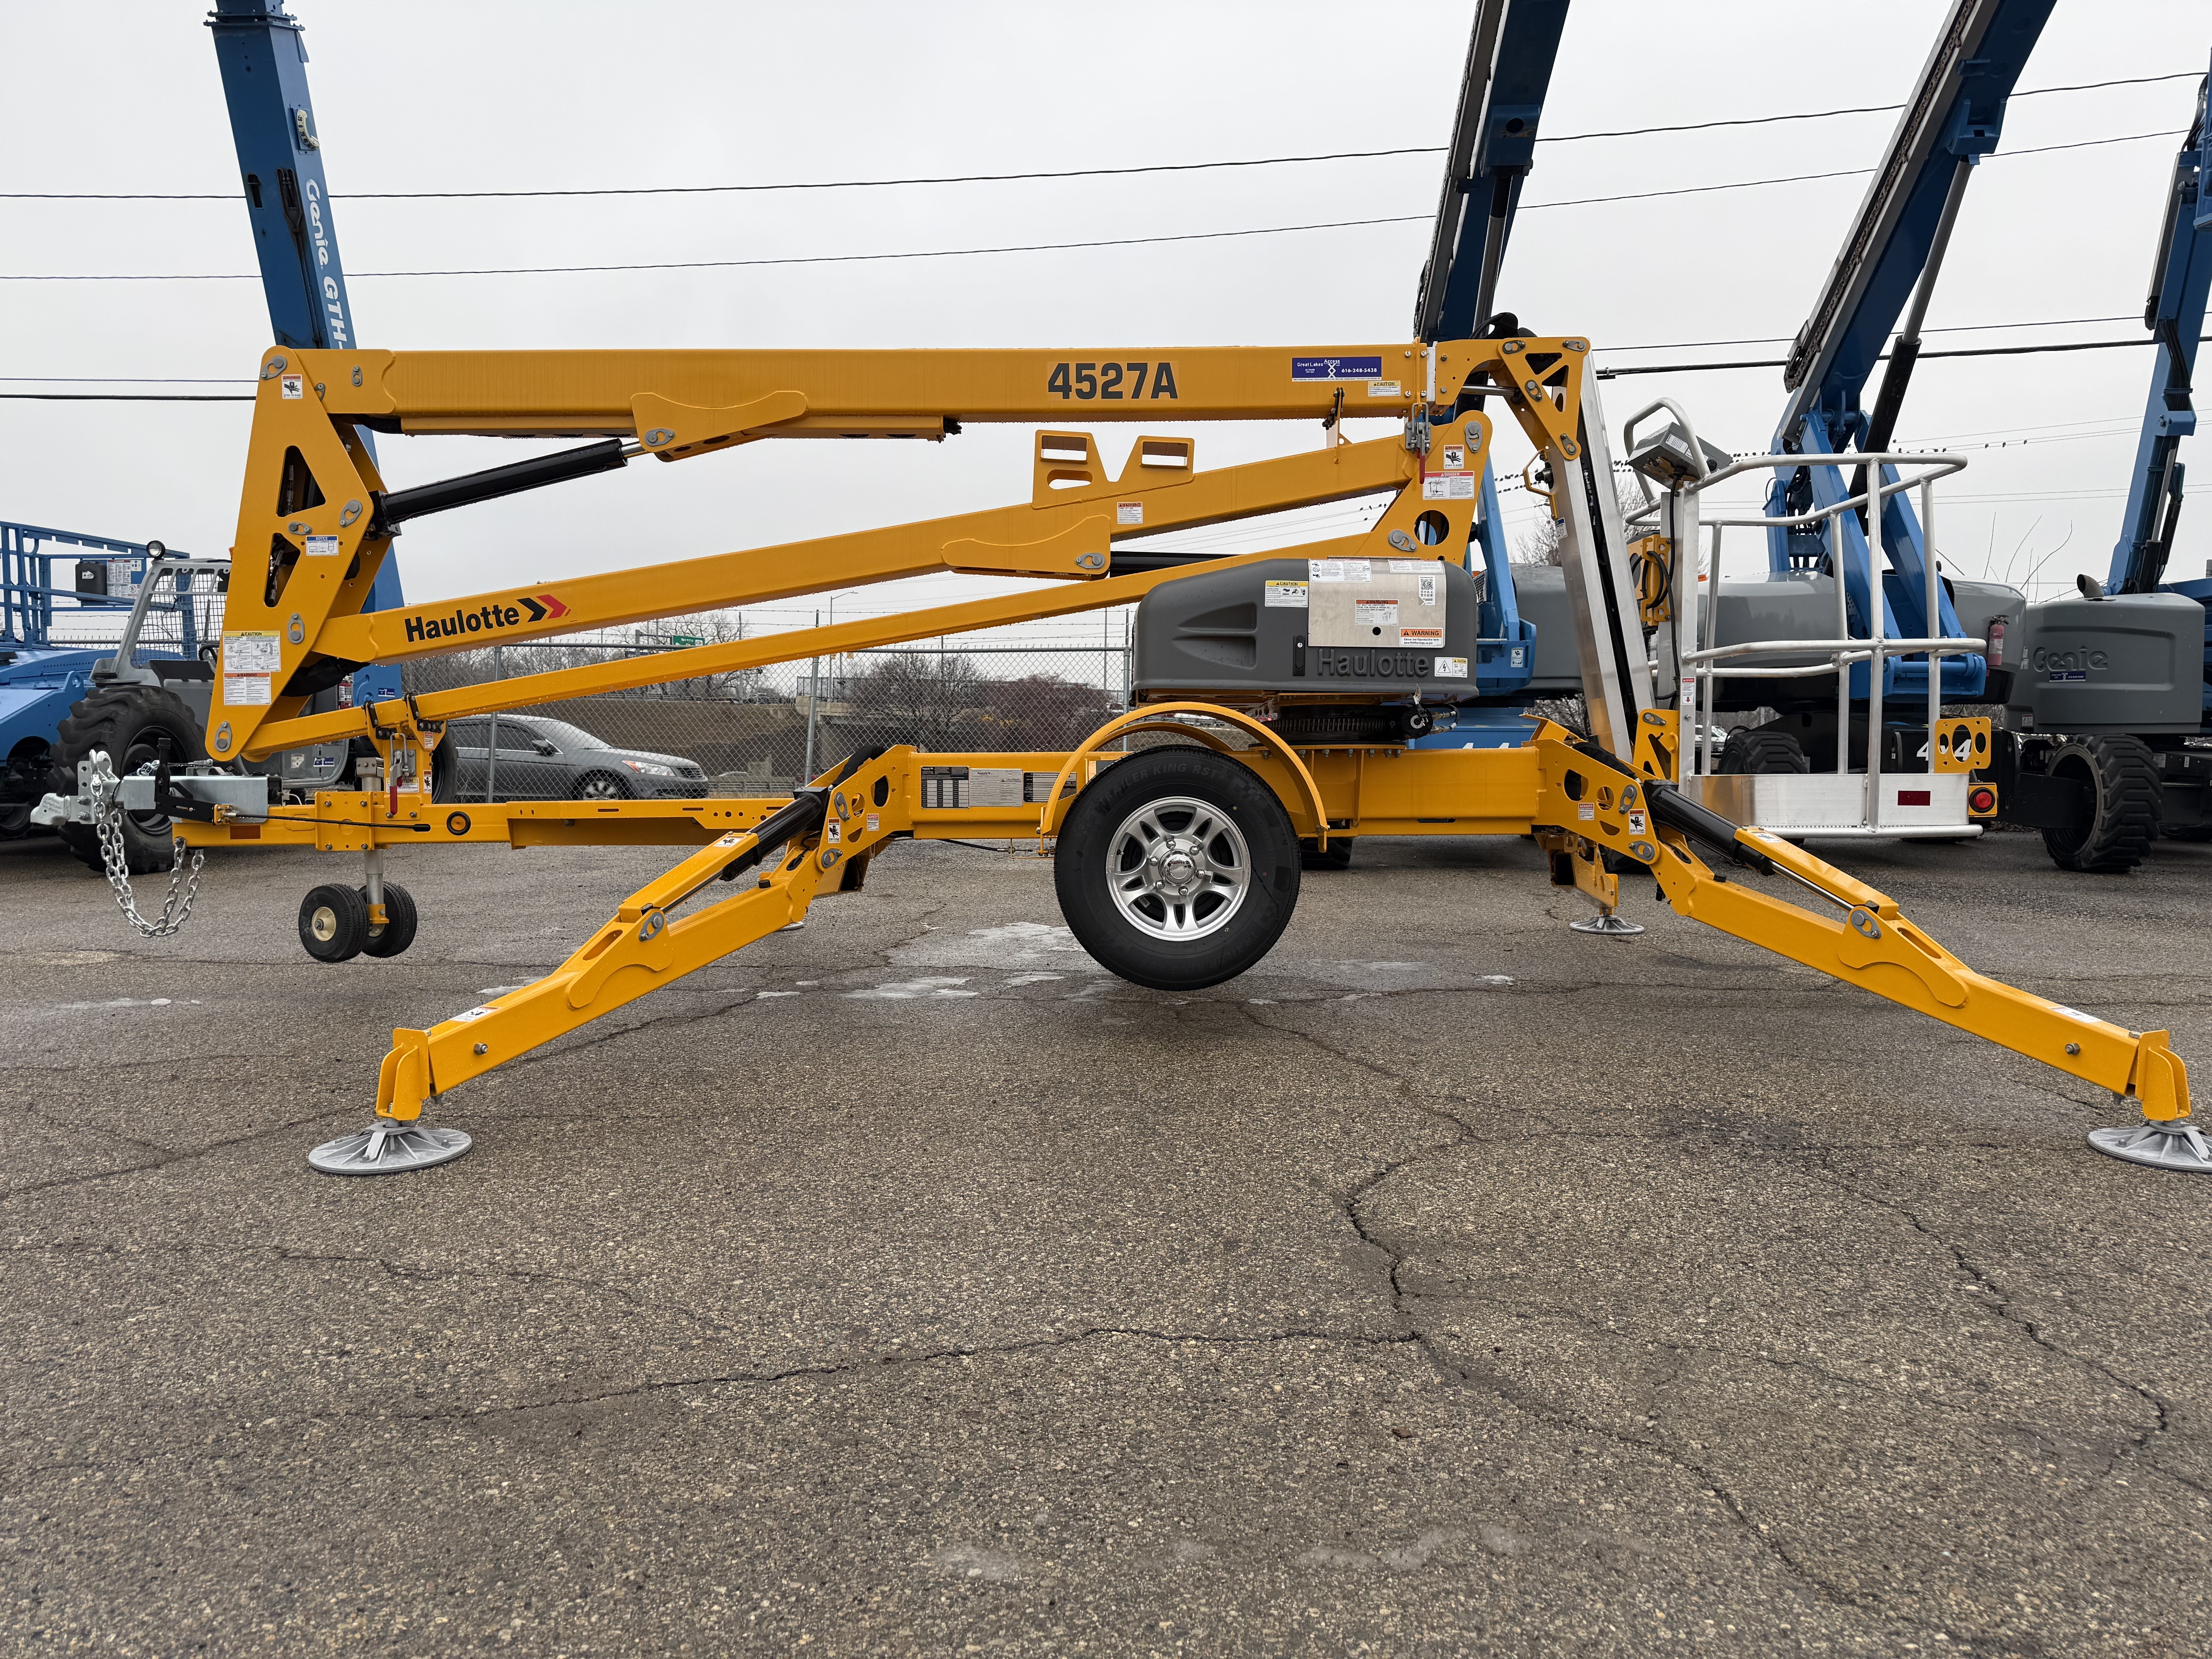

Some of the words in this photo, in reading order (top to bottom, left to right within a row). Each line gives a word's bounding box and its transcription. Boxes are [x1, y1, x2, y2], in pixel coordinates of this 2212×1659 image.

[306, 179, 329, 266] Genie
[1048, 362, 1178, 399] 4527A
[404, 605, 520, 642] Haulotte
[1317, 648, 1429, 677] Haulotte
[2033, 646, 2108, 672] Genie
[1098, 769, 1149, 806] TRAILER
[1153, 763, 1187, 776] KING
